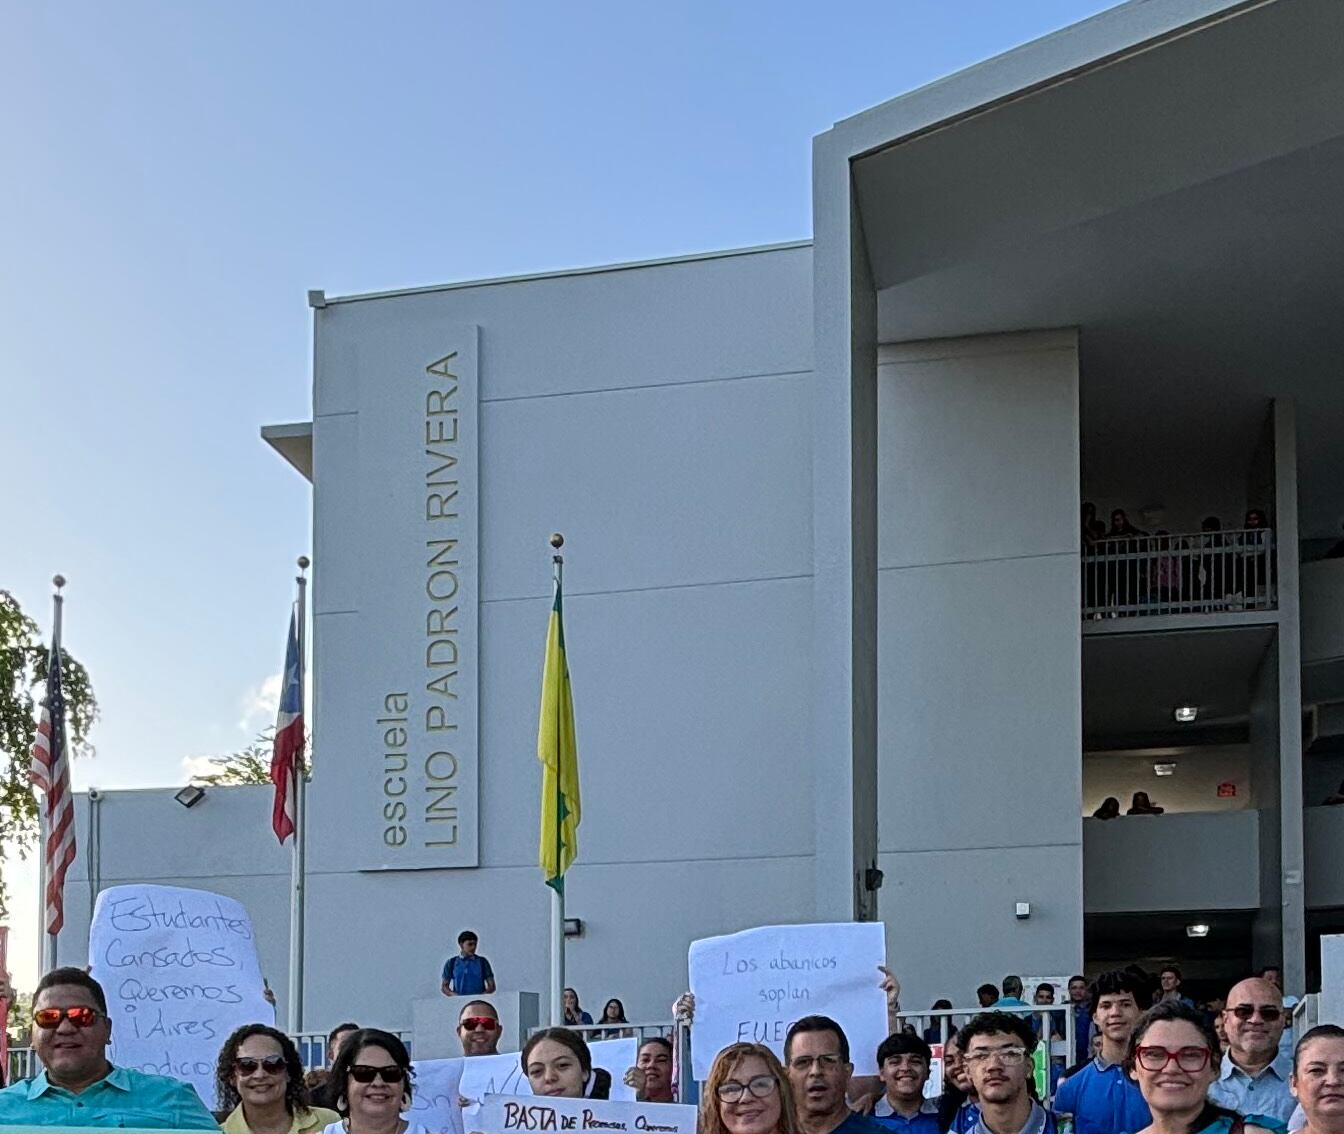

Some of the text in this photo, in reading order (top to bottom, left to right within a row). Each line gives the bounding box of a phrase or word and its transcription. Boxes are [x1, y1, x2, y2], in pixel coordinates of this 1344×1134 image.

[425, 351, 459, 849] LINO PADRON RIVERA
[376, 690, 410, 849] escuela
[110, 895, 252, 940] Estudiantes
[106, 936, 244, 971] Cansados,
[722, 950, 838, 976] Los abanicos
[119, 978, 244, 1004] Queremos
[758, 981, 810, 1012] soplan
[736, 1020, 793, 1044] FUE
[503, 1102, 557, 1131] BASTA
[560, 1114, 578, 1130] DE
